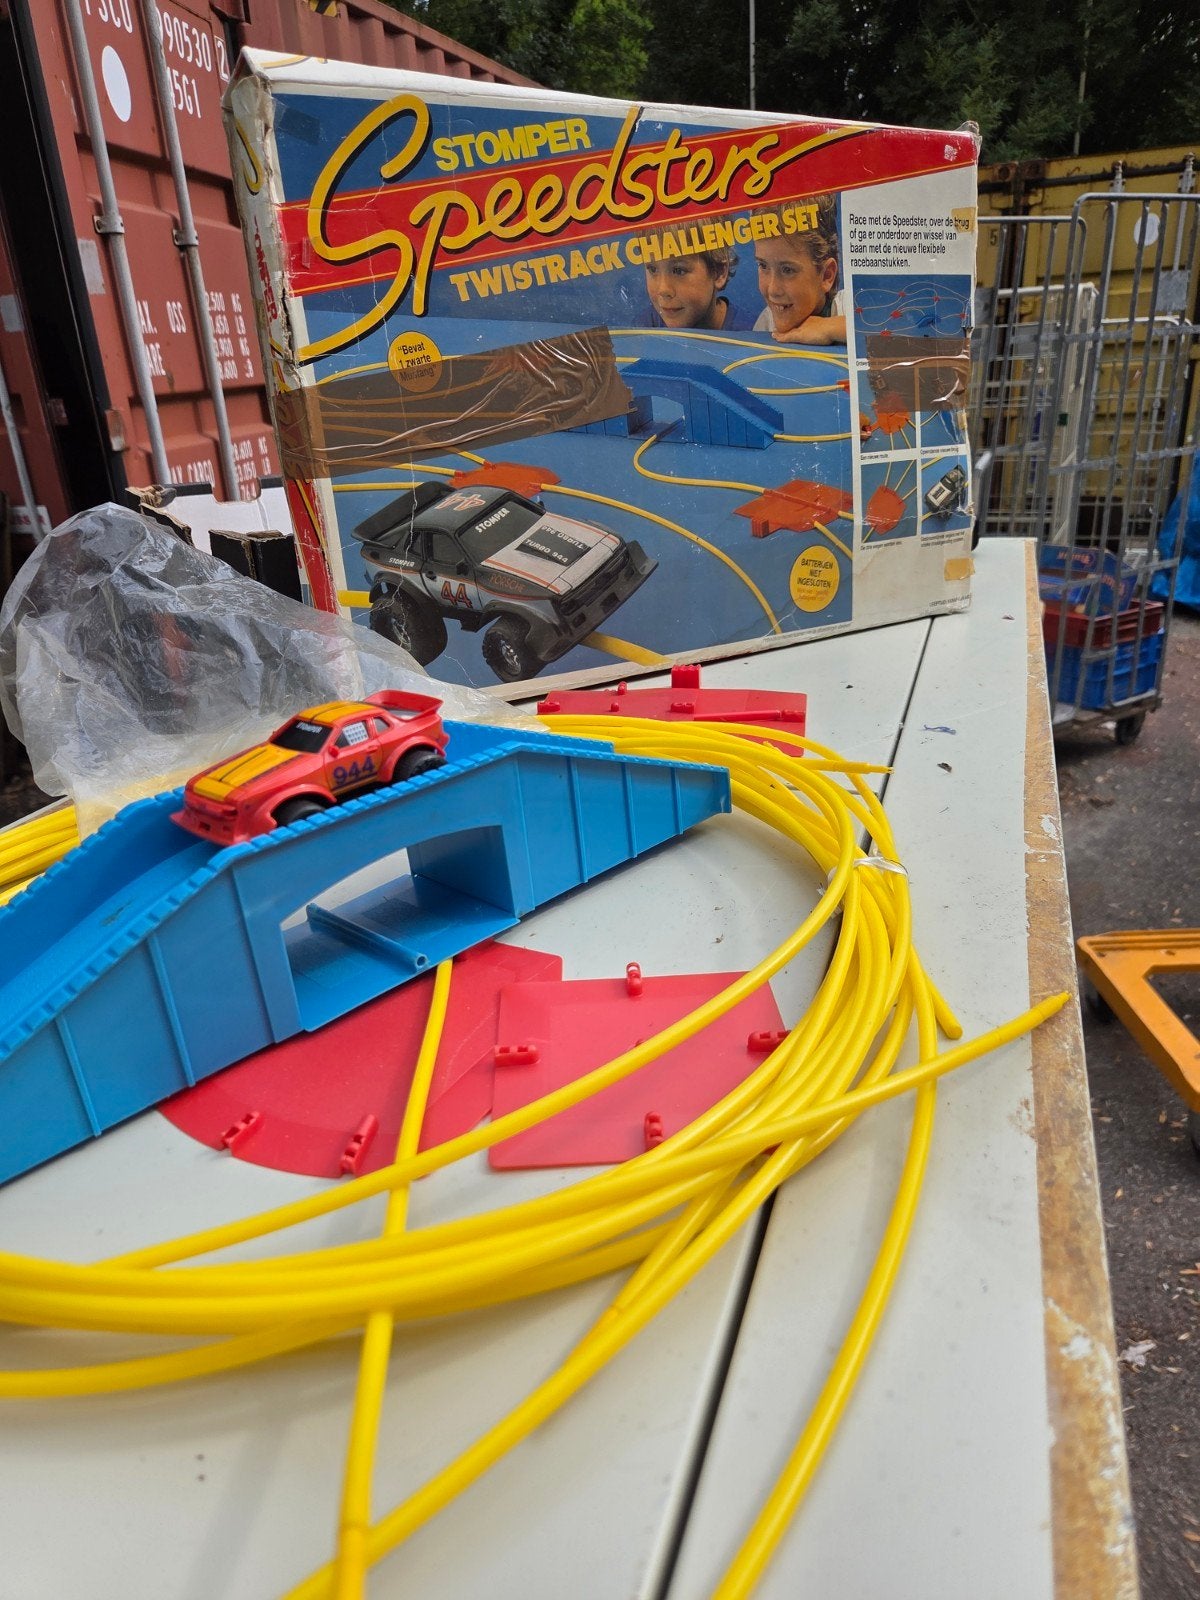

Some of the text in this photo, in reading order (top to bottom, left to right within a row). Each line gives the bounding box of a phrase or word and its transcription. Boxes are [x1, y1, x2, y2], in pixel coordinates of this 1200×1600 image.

[217, 40, 230, 80] 2
[432, 117, 592, 172] STOMPER
[296, 93, 882, 366] Speedsters
[849, 213, 970, 229] Race met de Speedster, over de brug
[849, 228, 957, 242] of ga er onderdoor en wissel van
[849, 242, 946, 254] baan met de nieuwe flexibele
[449, 203, 822, 302] TWISTRACK CHALLENGER SET
[850, 257, 911, 268] racebaanstukken.
[145, 342, 166, 376] ARE
[398, 353, 432, 370] 1 zwarte
[474, 507, 511, 534] STOMPER
[388, 557, 416, 568] STOMPER
[525, 538, 569, 564] TURBO 944
[440, 580, 473, 609] 44
[332, 755, 377, 787] 944
